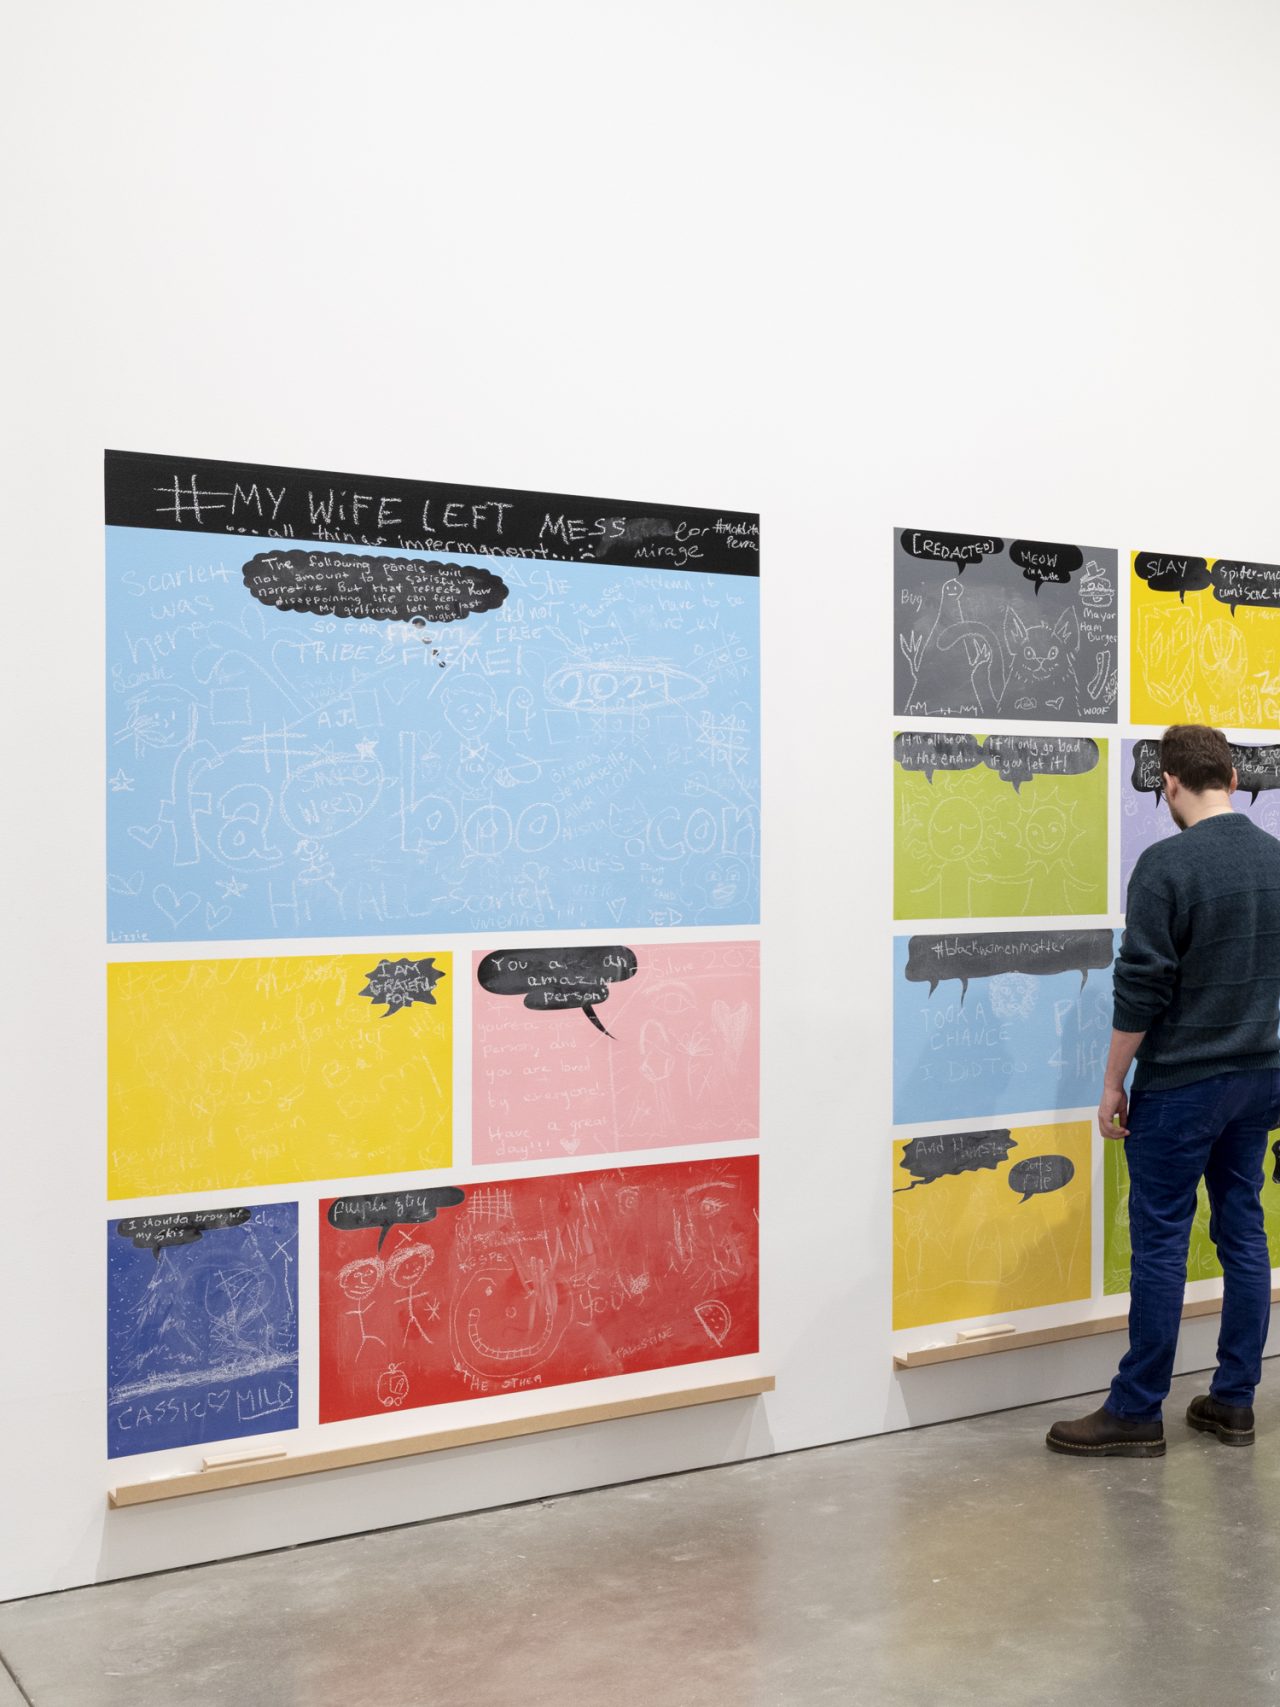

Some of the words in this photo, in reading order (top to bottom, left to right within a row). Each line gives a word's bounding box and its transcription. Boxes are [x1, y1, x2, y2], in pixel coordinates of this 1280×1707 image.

[422, 500, 514, 535] LEFT
[539, 513, 627, 545] MESS
[312, 525, 387, 547] things
[912, 532, 995, 560] [REDACTED]
[261, 557, 294, 571] The
[308, 556, 371, 573] following
[382, 562, 426, 578] panels
[438, 567, 462, 578] will
[1020, 551, 1058, 568] MEOW
[1146, 558, 1188, 579] SLAY
[253, 574, 279, 585] not
[295, 571, 350, 582] amount
[360, 573, 374, 583] to
[386, 575, 393, 583] a
[405, 574, 476, 588] satisfying
[337, 582, 363, 593] But
[372, 584, 403, 594] that
[413, 584, 461, 595] reflects
[468, 585, 493, 596] how
[150, 594, 215, 620] was
[276, 595, 362, 607] disappointing
[373, 594, 396, 603] life
[406, 595, 426, 603] can
[319, 604, 337, 615] My
[343, 604, 399, 616] girlfriend
[406, 604, 430, 613] left
[435, 604, 451, 612] me
[459, 600, 482, 615] last
[901, 588, 923, 613] Bug
[1080, 622, 1102, 633] Ham
[290, 641, 375, 665] TRIBE
[927, 734, 941, 745] all
[1017, 740, 1039, 756] only
[1043, 744, 1056, 756] go
[1058, 739, 1081, 753] bad
[916, 752, 938, 766] the
[1002, 758, 1023, 775] you
[1027, 755, 1044, 772] let
[378, 961, 391, 978] I
[394, 963, 421, 978] AM
[491, 956, 528, 972] You
[385, 992, 414, 1008] FOR
[975, 1002, 988, 1025] A
[929, 1021, 1014, 1051] CHANCE
[486, 1066, 512, 1085] you
[523, 1062, 553, 1076] are
[560, 1054, 591, 1073] loved
[488, 1090, 510, 1116] by
[915, 1135, 945, 1160] And
[128, 1219, 136, 1231] I
[142, 1214, 189, 1229] shoulda
[135, 1230, 152, 1242] my
